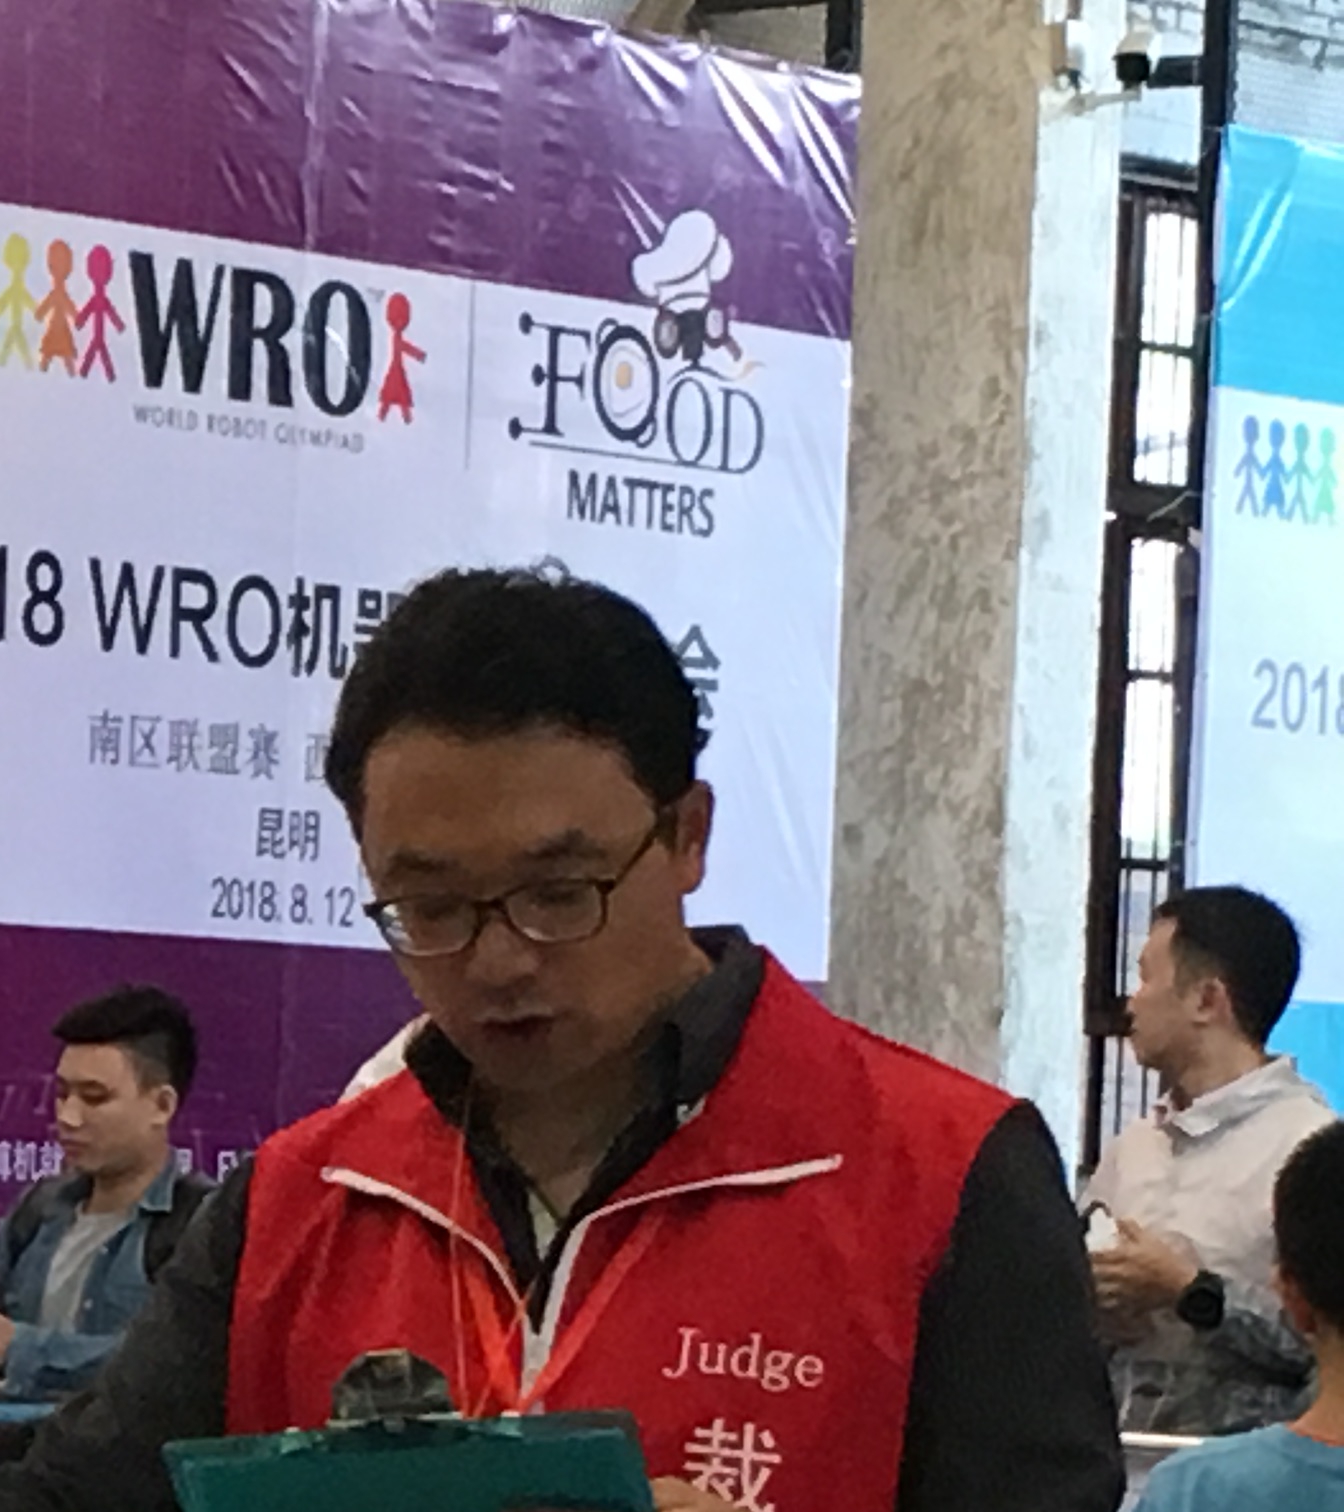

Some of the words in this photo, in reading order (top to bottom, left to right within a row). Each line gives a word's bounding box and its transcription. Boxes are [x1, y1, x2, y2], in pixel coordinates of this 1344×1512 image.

[129, 249, 372, 418] WRO
[132, 404, 199, 432] WORLD
[207, 413, 267, 441] ROBOT
[273, 421, 365, 455] OLYMPIAD
[566, 469, 715, 538] MATTERS
[87, 709, 281, 782] 南区联盟赛
[255, 807, 320, 862] 昆明
[210, 876, 356, 928] 2018.8.12
[662, 1326, 825, 1392] Judge
